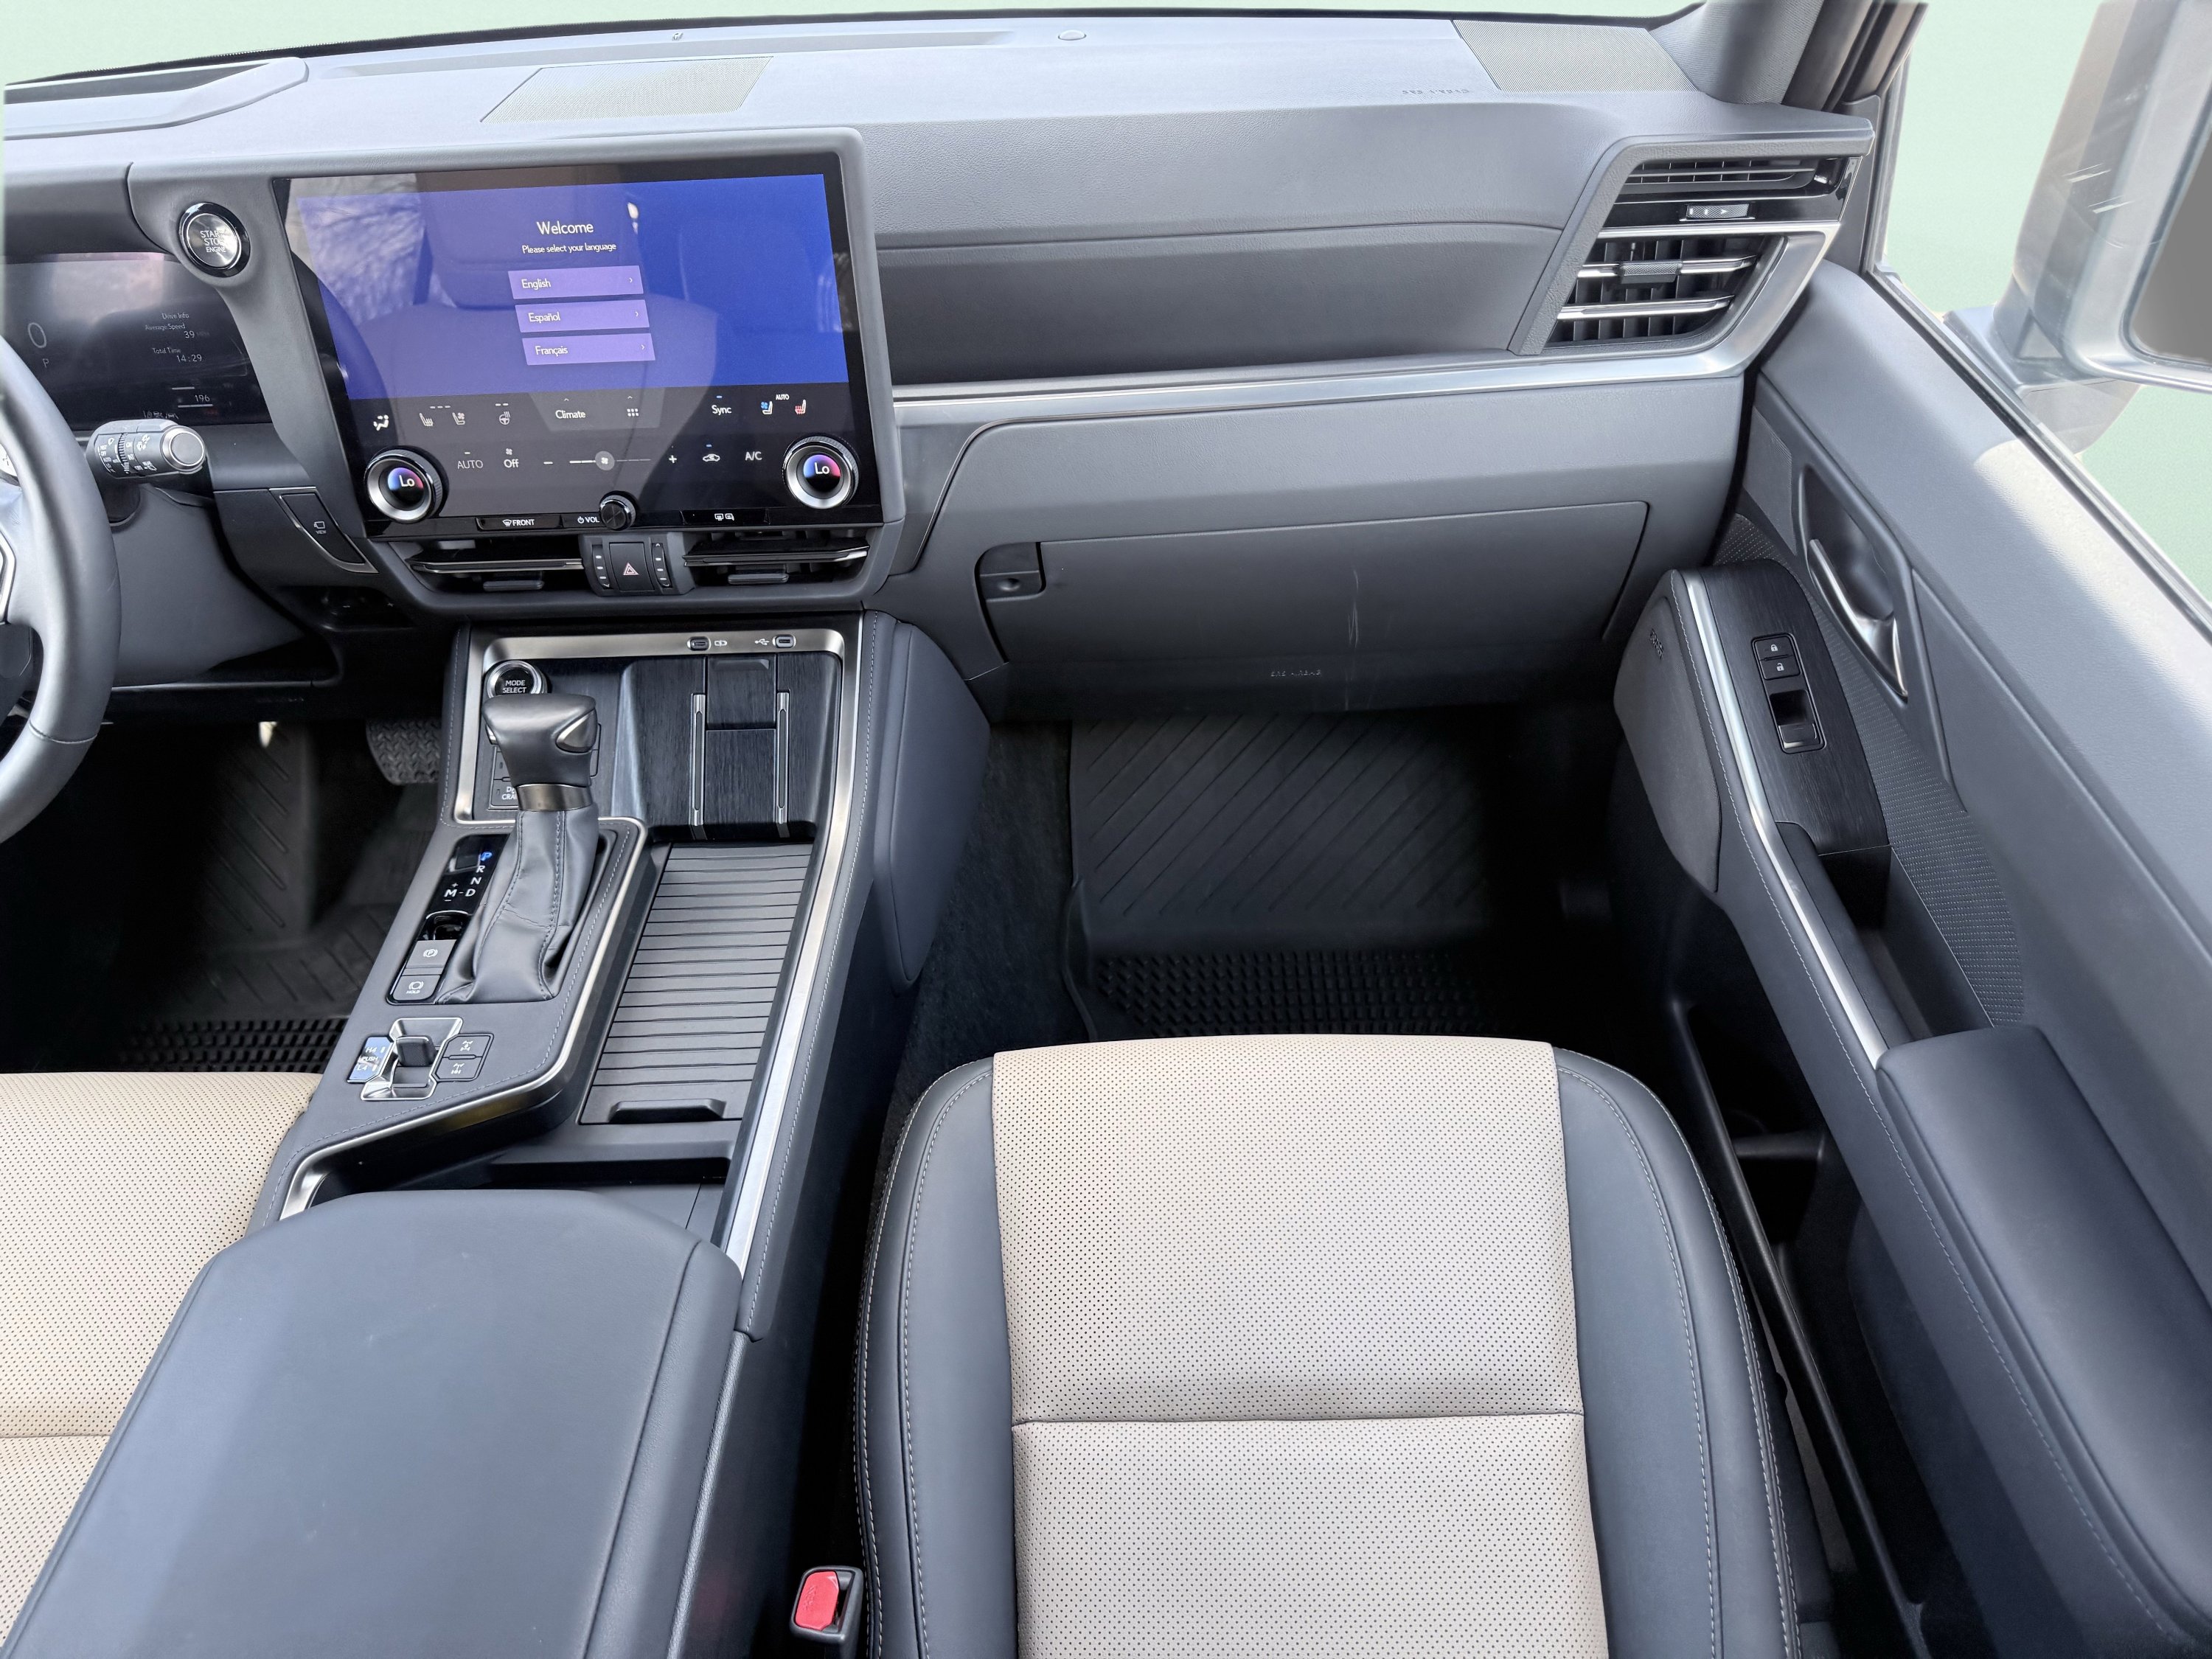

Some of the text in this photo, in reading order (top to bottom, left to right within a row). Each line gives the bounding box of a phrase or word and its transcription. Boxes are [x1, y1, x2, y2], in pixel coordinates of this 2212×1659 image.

[536, 221, 594, 234] Welcome
[521, 242, 616, 254] Please select your language
[521, 279, 552, 289] English
[528, 311, 560, 323] Español
[184, 330, 195, 338] 39
[535, 345, 568, 356] Français
[177, 354, 202, 362] 14:29
[555, 410, 586, 419] Climate
[712, 405, 732, 416] Sync
[745, 451, 762, 461] A/C
[457, 459, 484, 469] AUTO
[504, 459, 519, 468] Off
[814, 462, 830, 475] Lo
[399, 475, 415, 487] Lo
[481, 851, 493, 861] P
[476, 865, 486, 873] R
[470, 877, 482, 885] N
